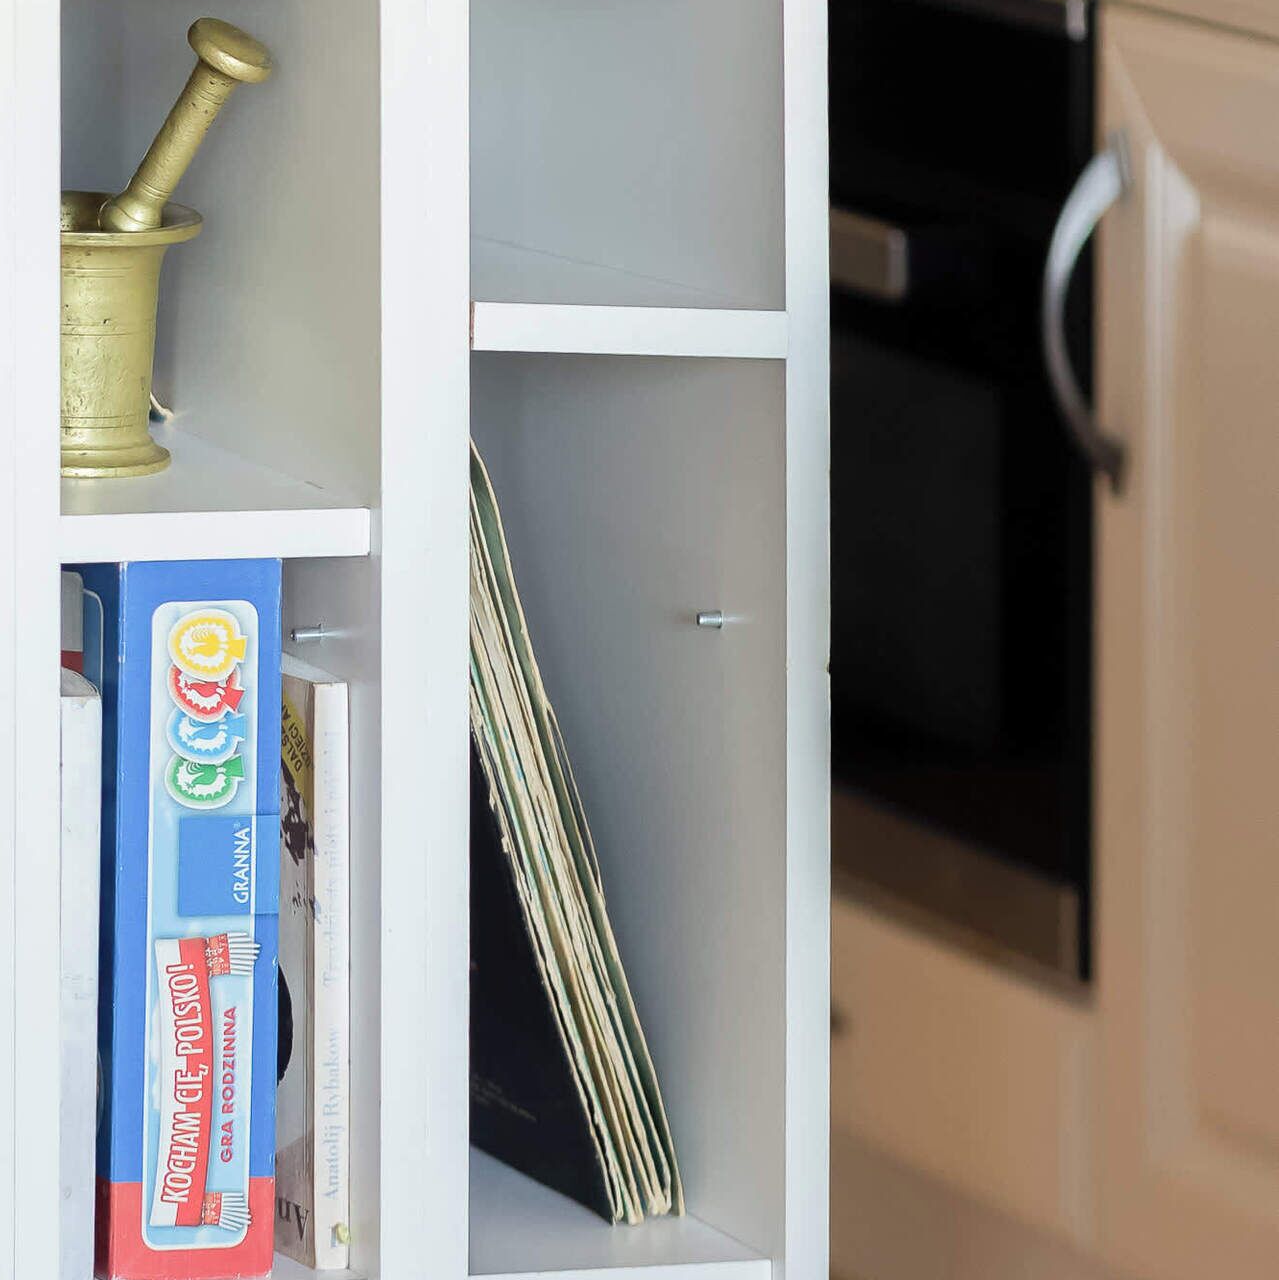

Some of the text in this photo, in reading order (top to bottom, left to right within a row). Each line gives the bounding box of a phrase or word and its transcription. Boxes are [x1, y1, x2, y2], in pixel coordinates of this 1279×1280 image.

[233, 827, 250, 903] GRANNA
[160, 963, 209, 1204] KOCHAM CIĘ, POLSKO!
[220, 1007, 236, 1163] GRA RODZINNA
[323, 1125, 344, 1200] Anatolij
